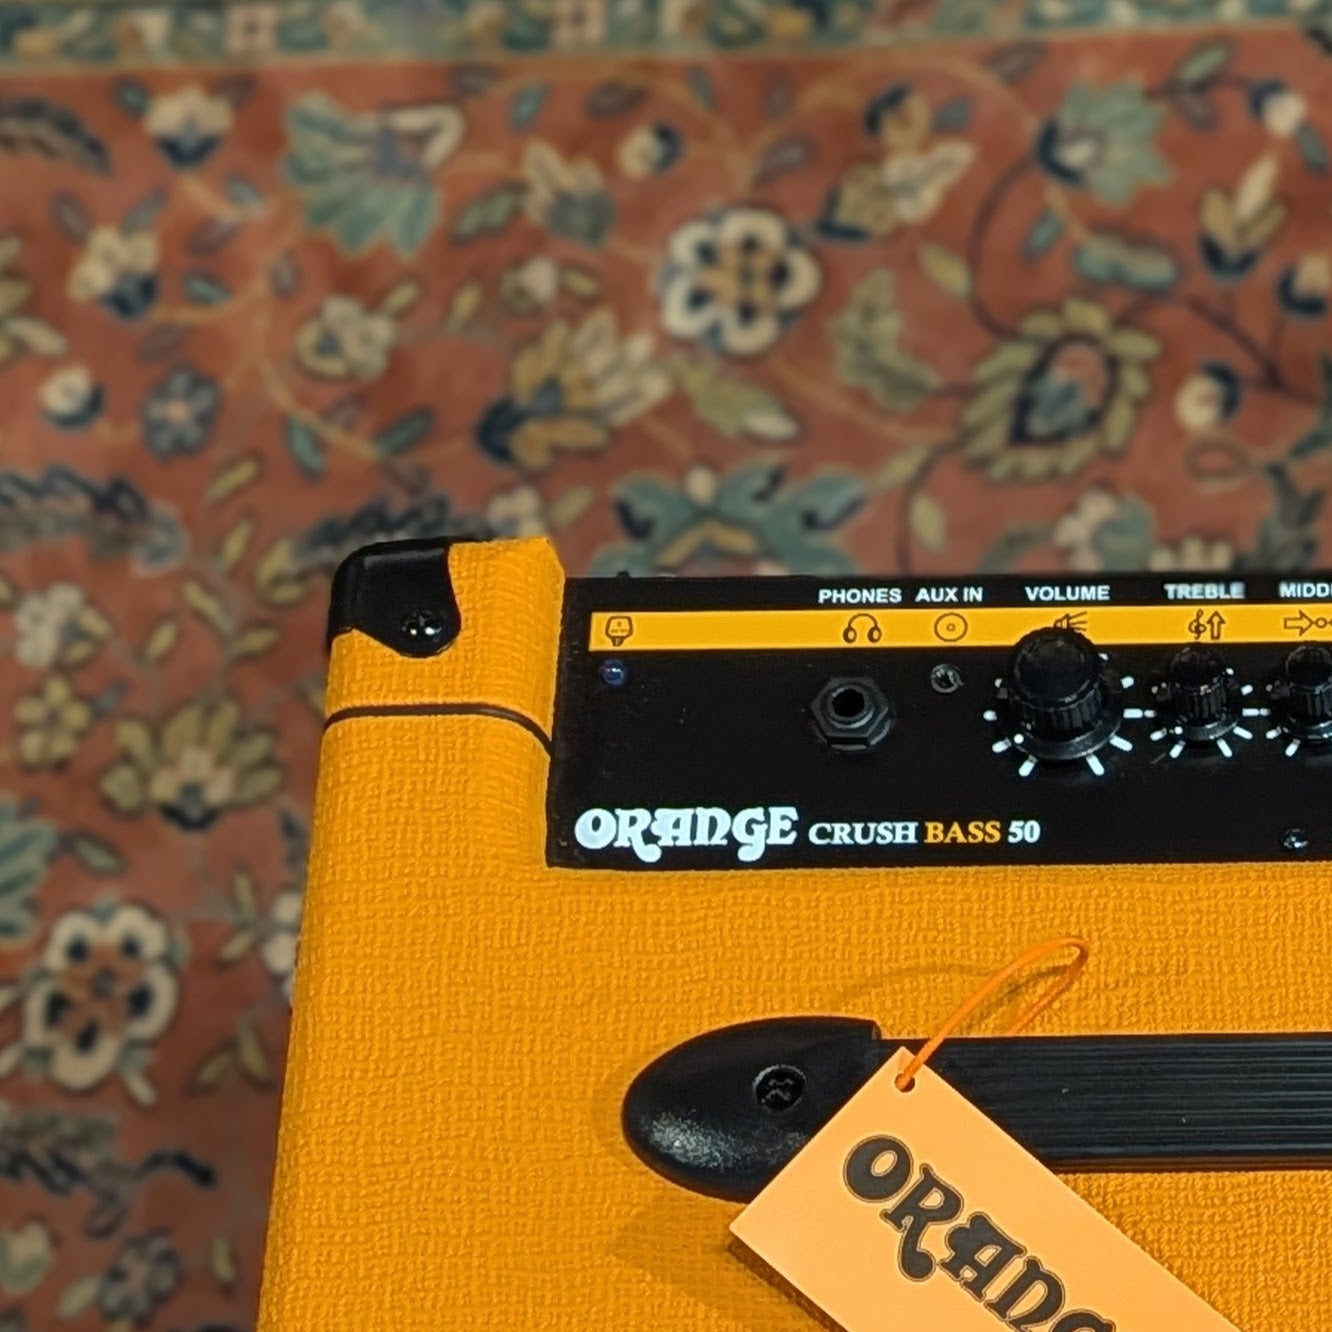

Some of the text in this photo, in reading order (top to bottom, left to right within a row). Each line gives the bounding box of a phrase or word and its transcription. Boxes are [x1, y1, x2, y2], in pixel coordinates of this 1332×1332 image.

[817, 587, 903, 604] PHONES
[914, 586, 984, 603] AUX IN
[1024, 584, 1111, 602] VOLUME
[1163, 582, 1245, 600] TREBLE
[573, 806, 1041, 864] ORANGE CRUSH BASS 50
